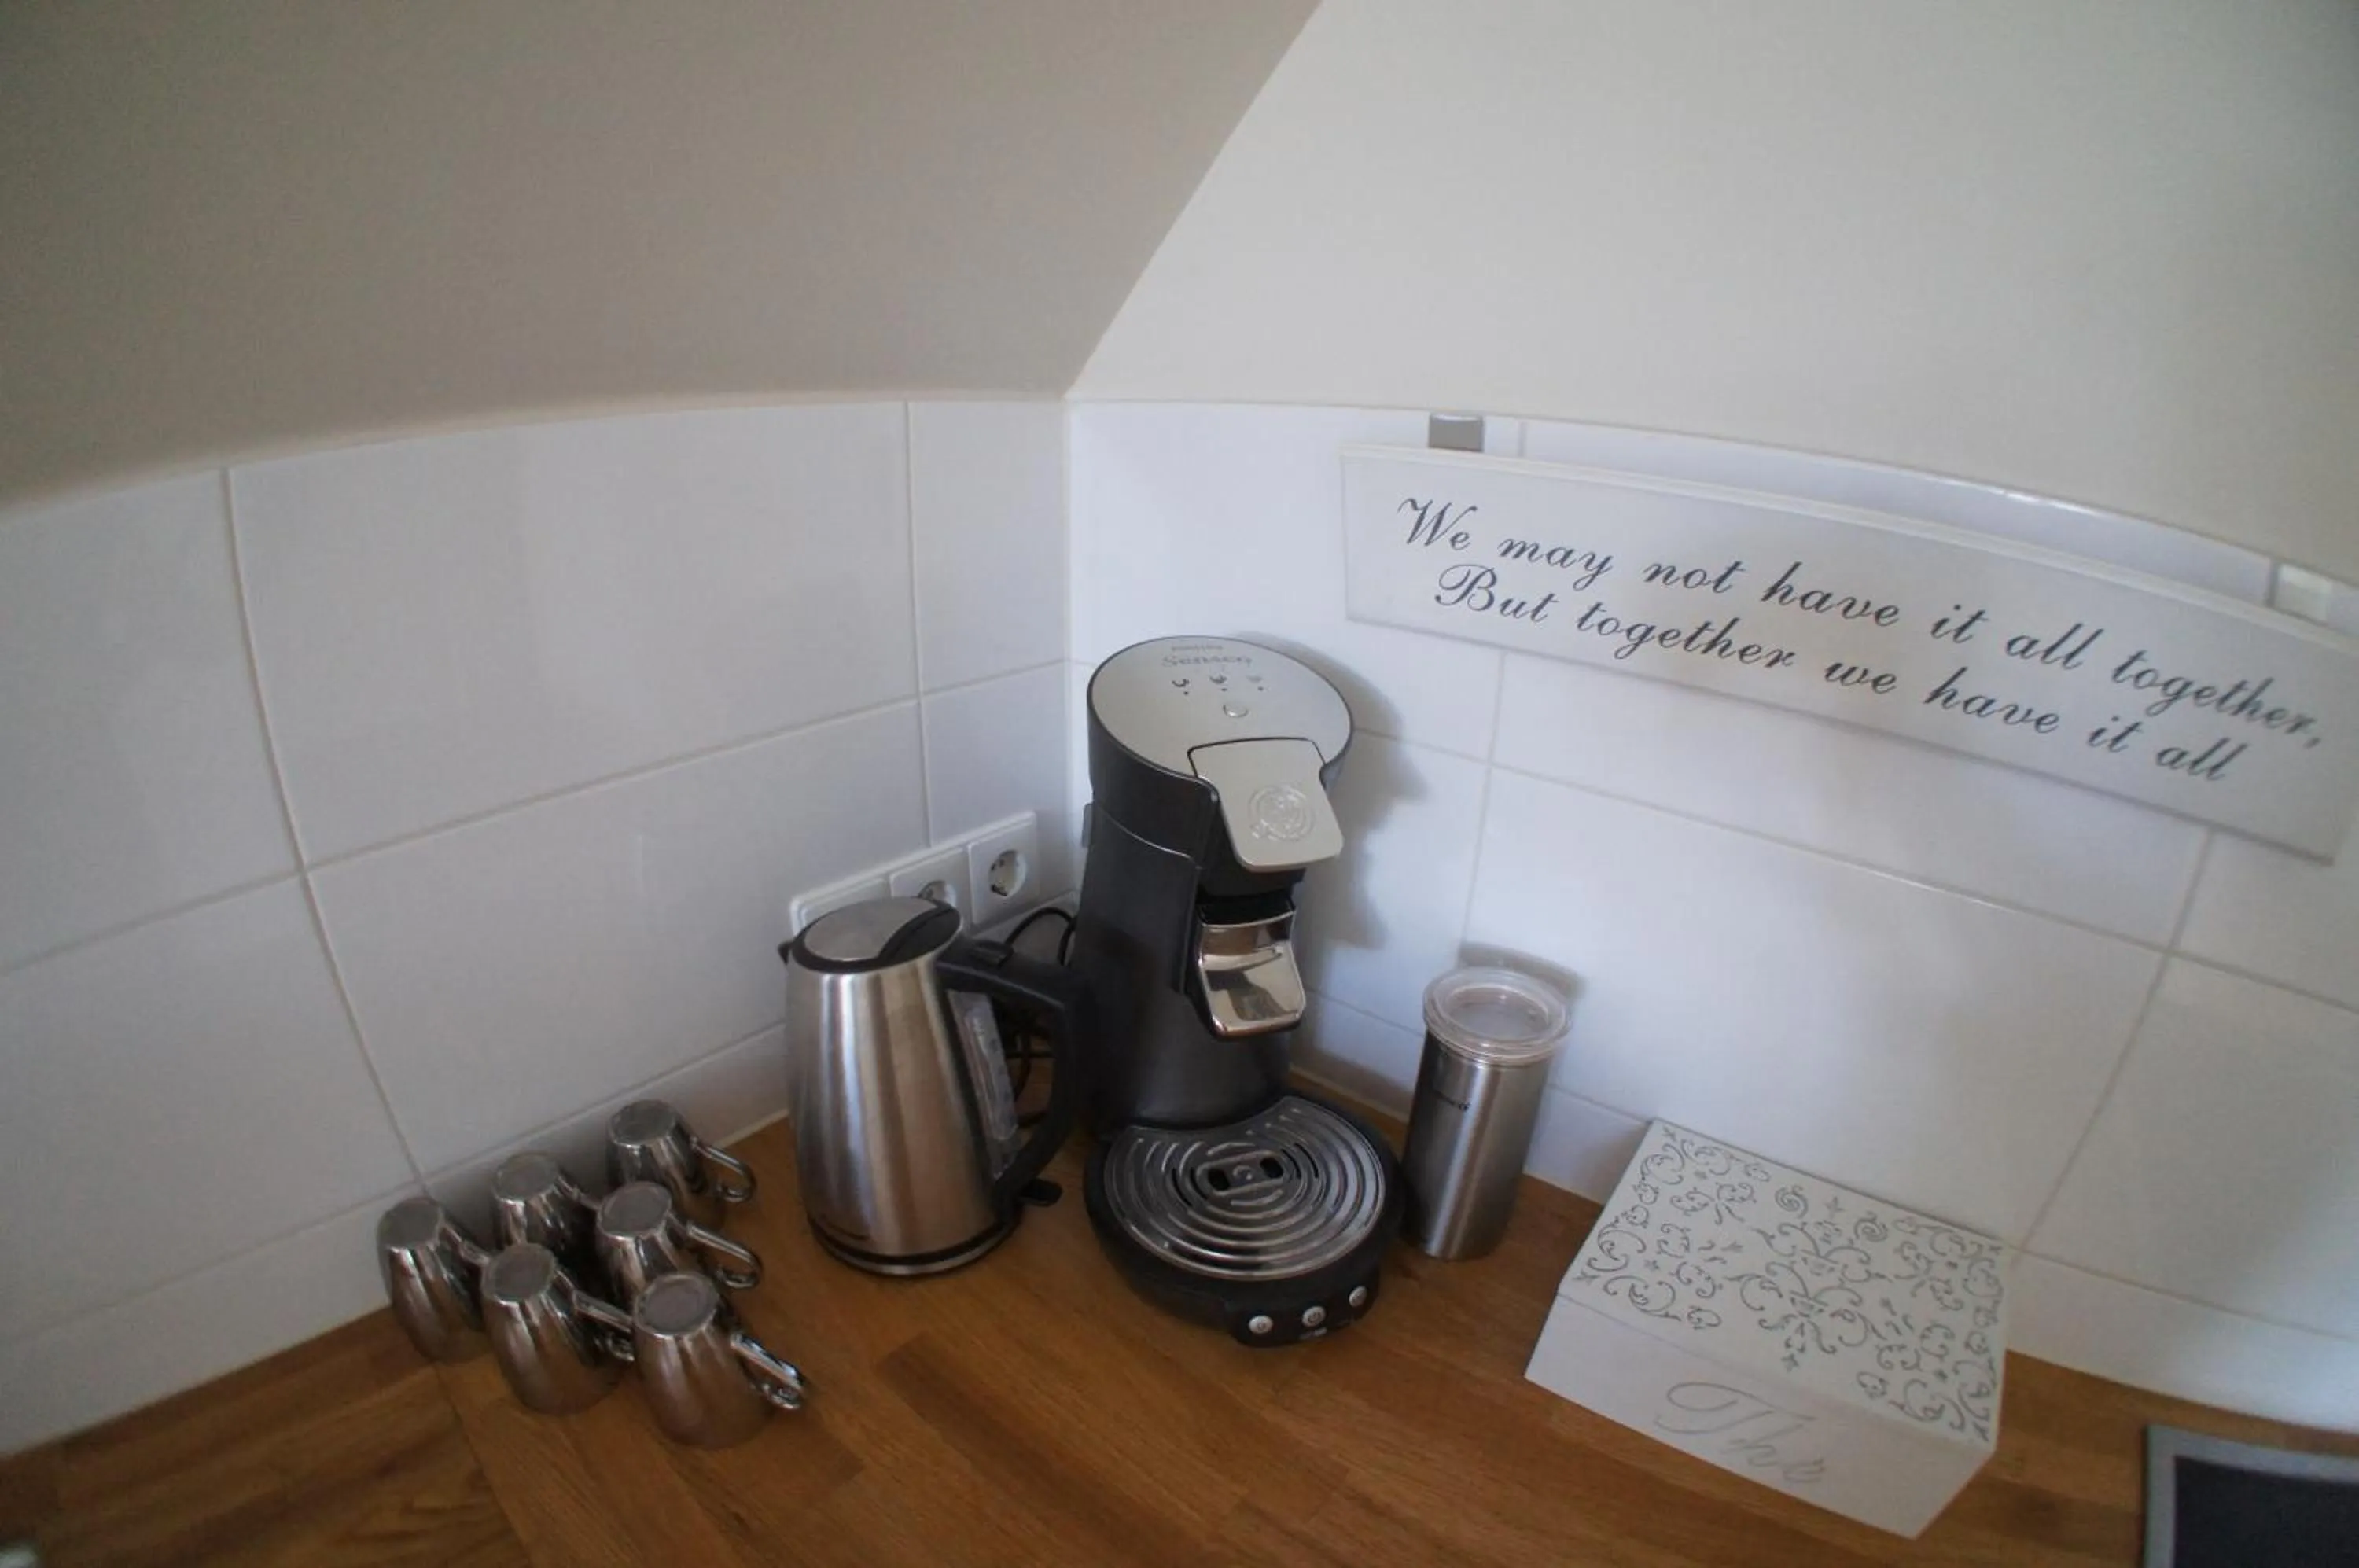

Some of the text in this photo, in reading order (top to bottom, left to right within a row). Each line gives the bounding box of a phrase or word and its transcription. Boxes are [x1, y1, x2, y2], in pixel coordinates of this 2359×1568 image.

[1396, 497, 2321, 749] We may not have it all together,
[1434, 563, 2249, 782] But together we have it all
